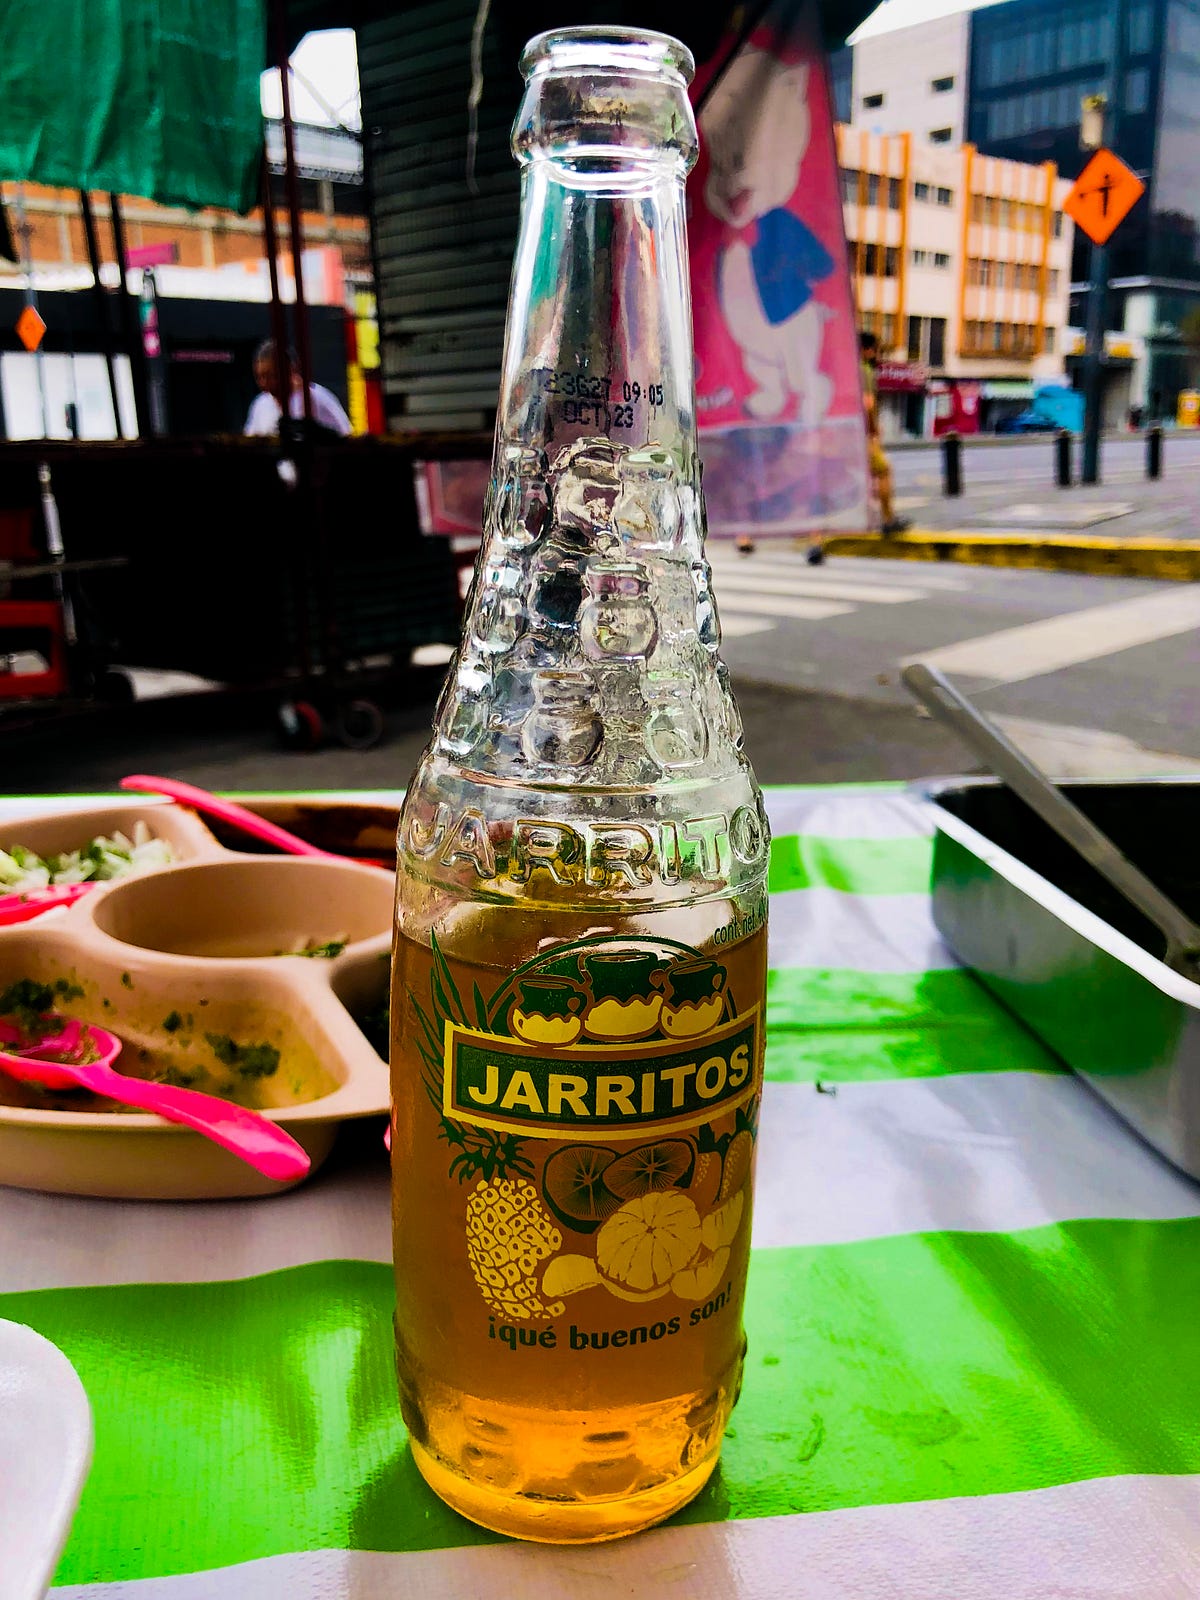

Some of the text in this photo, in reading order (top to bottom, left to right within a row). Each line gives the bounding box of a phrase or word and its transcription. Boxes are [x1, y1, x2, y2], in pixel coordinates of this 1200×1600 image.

[562, 400, 634, 429] OCT 23
[622, 380, 664, 407] 09:05
[468, 1043, 750, 1117] JARRITOS
[487, 1281, 733, 1351] ¡qué buenos son!
